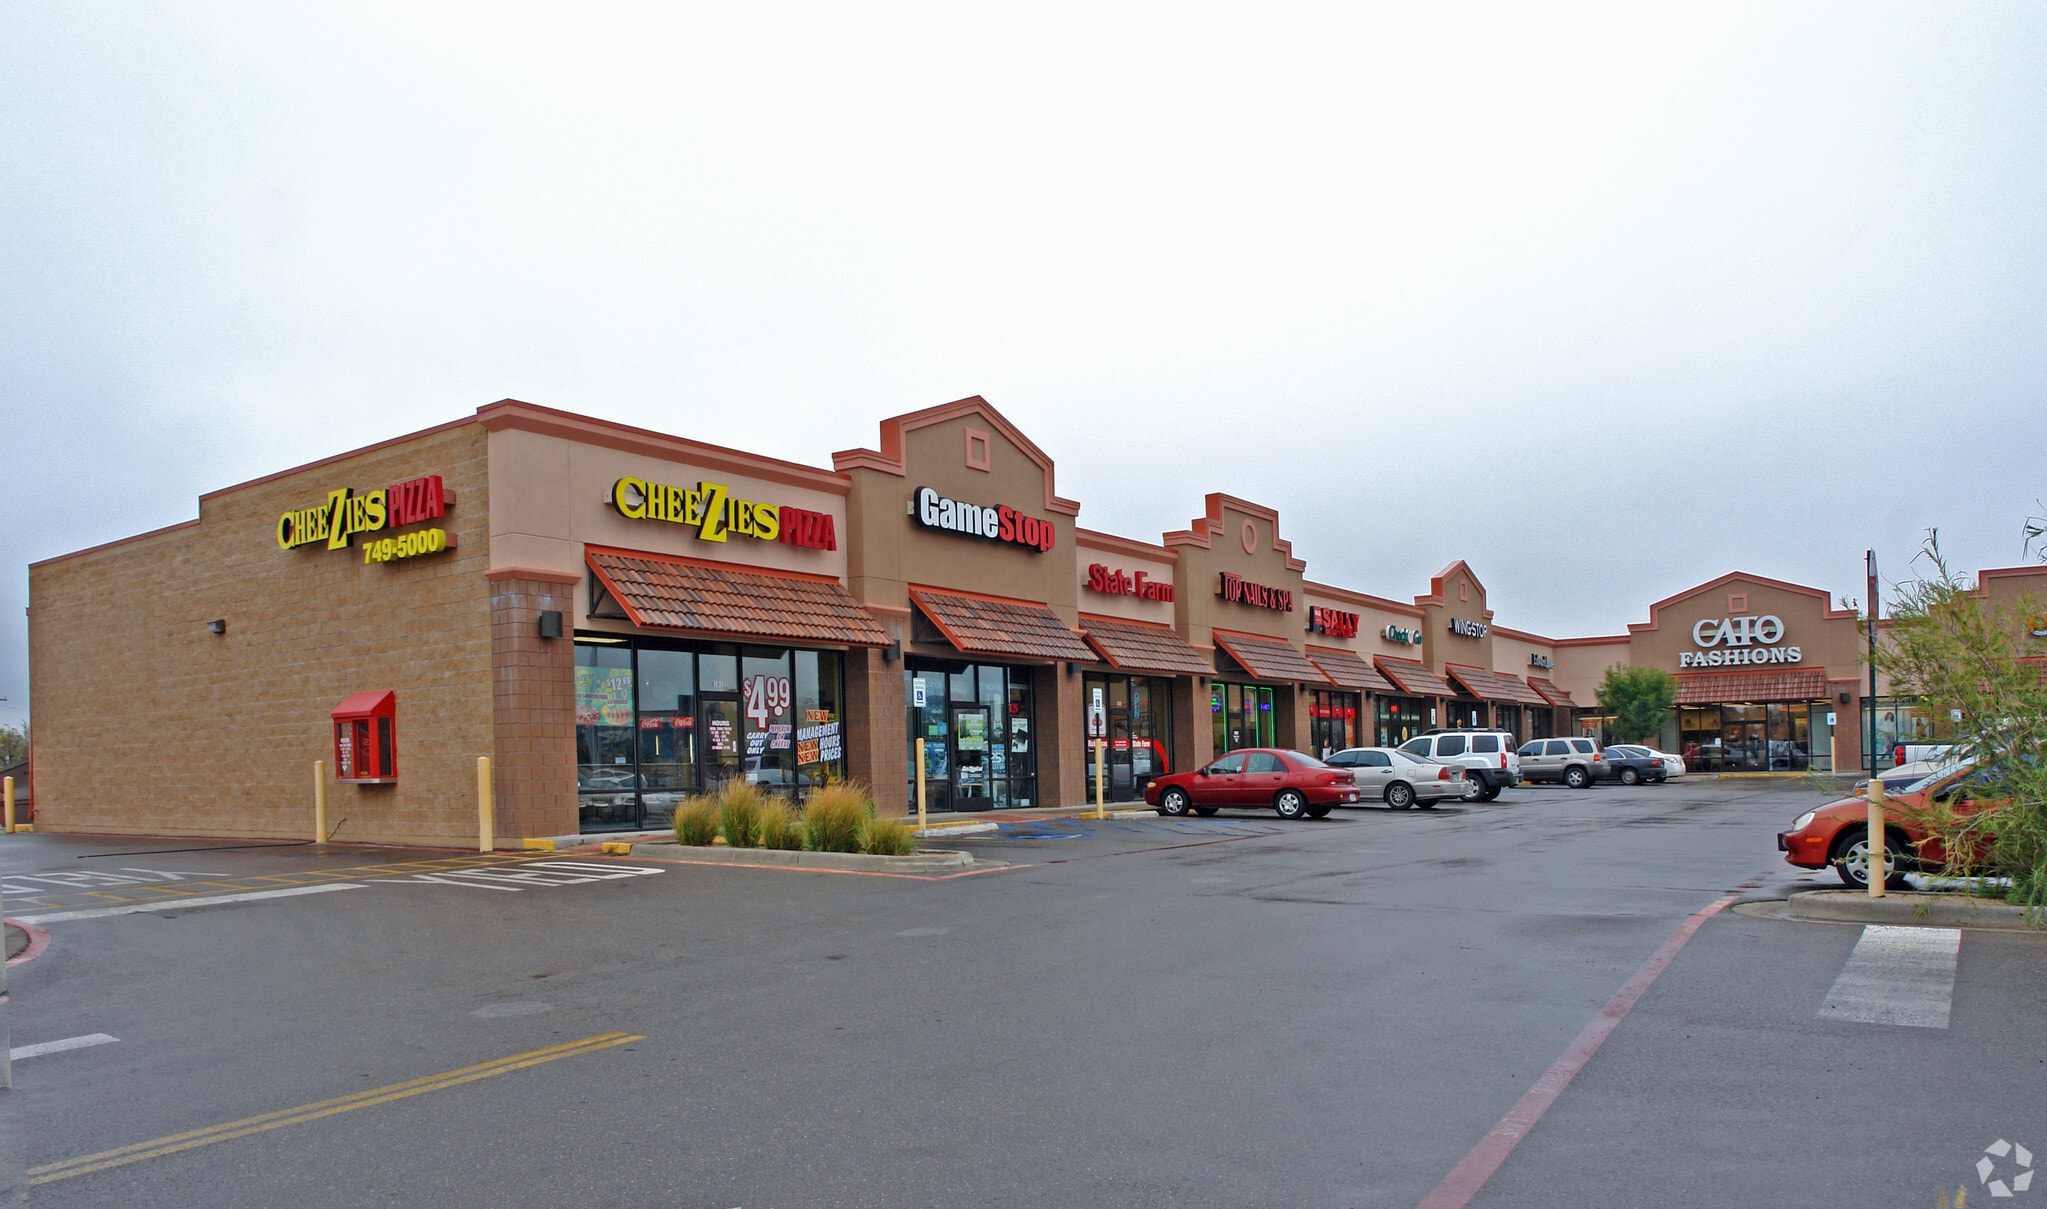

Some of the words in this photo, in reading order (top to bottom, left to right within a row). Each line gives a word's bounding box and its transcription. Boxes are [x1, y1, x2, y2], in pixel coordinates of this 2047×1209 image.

[389, 475, 445, 528] PIZZA
[779, 506, 837, 551] PIZZA
[919, 486, 1055, 552] GameStop
[362, 528, 446, 565] 749-5000
[1089, 564, 1132, 596] State
[1135, 571, 1175, 603] Farm
[1222, 572, 1242, 601] TOP
[1243, 580, 1268, 607] NAILS
[1270, 587, 1277, 609] &
[1278, 590, 1293, 612] SPA
[1322, 607, 1360, 632] SALLY
[1692, 615, 1785, 648] CATO
[1679, 646, 1802, 668] FASHIONS
[806, 710, 828, 721] NEW
[746, 731, 769, 740] CARRY
[750, 739, 764, 747] OUT
[797, 722, 839, 741] MANAGEMENT
[746, 746, 765, 755] ONLY
[797, 739, 818, 753] NEW
[820, 735, 841, 750] HOURS
[797, 751, 819, 764] NEW
[820, 747, 842, 763] PRICES
